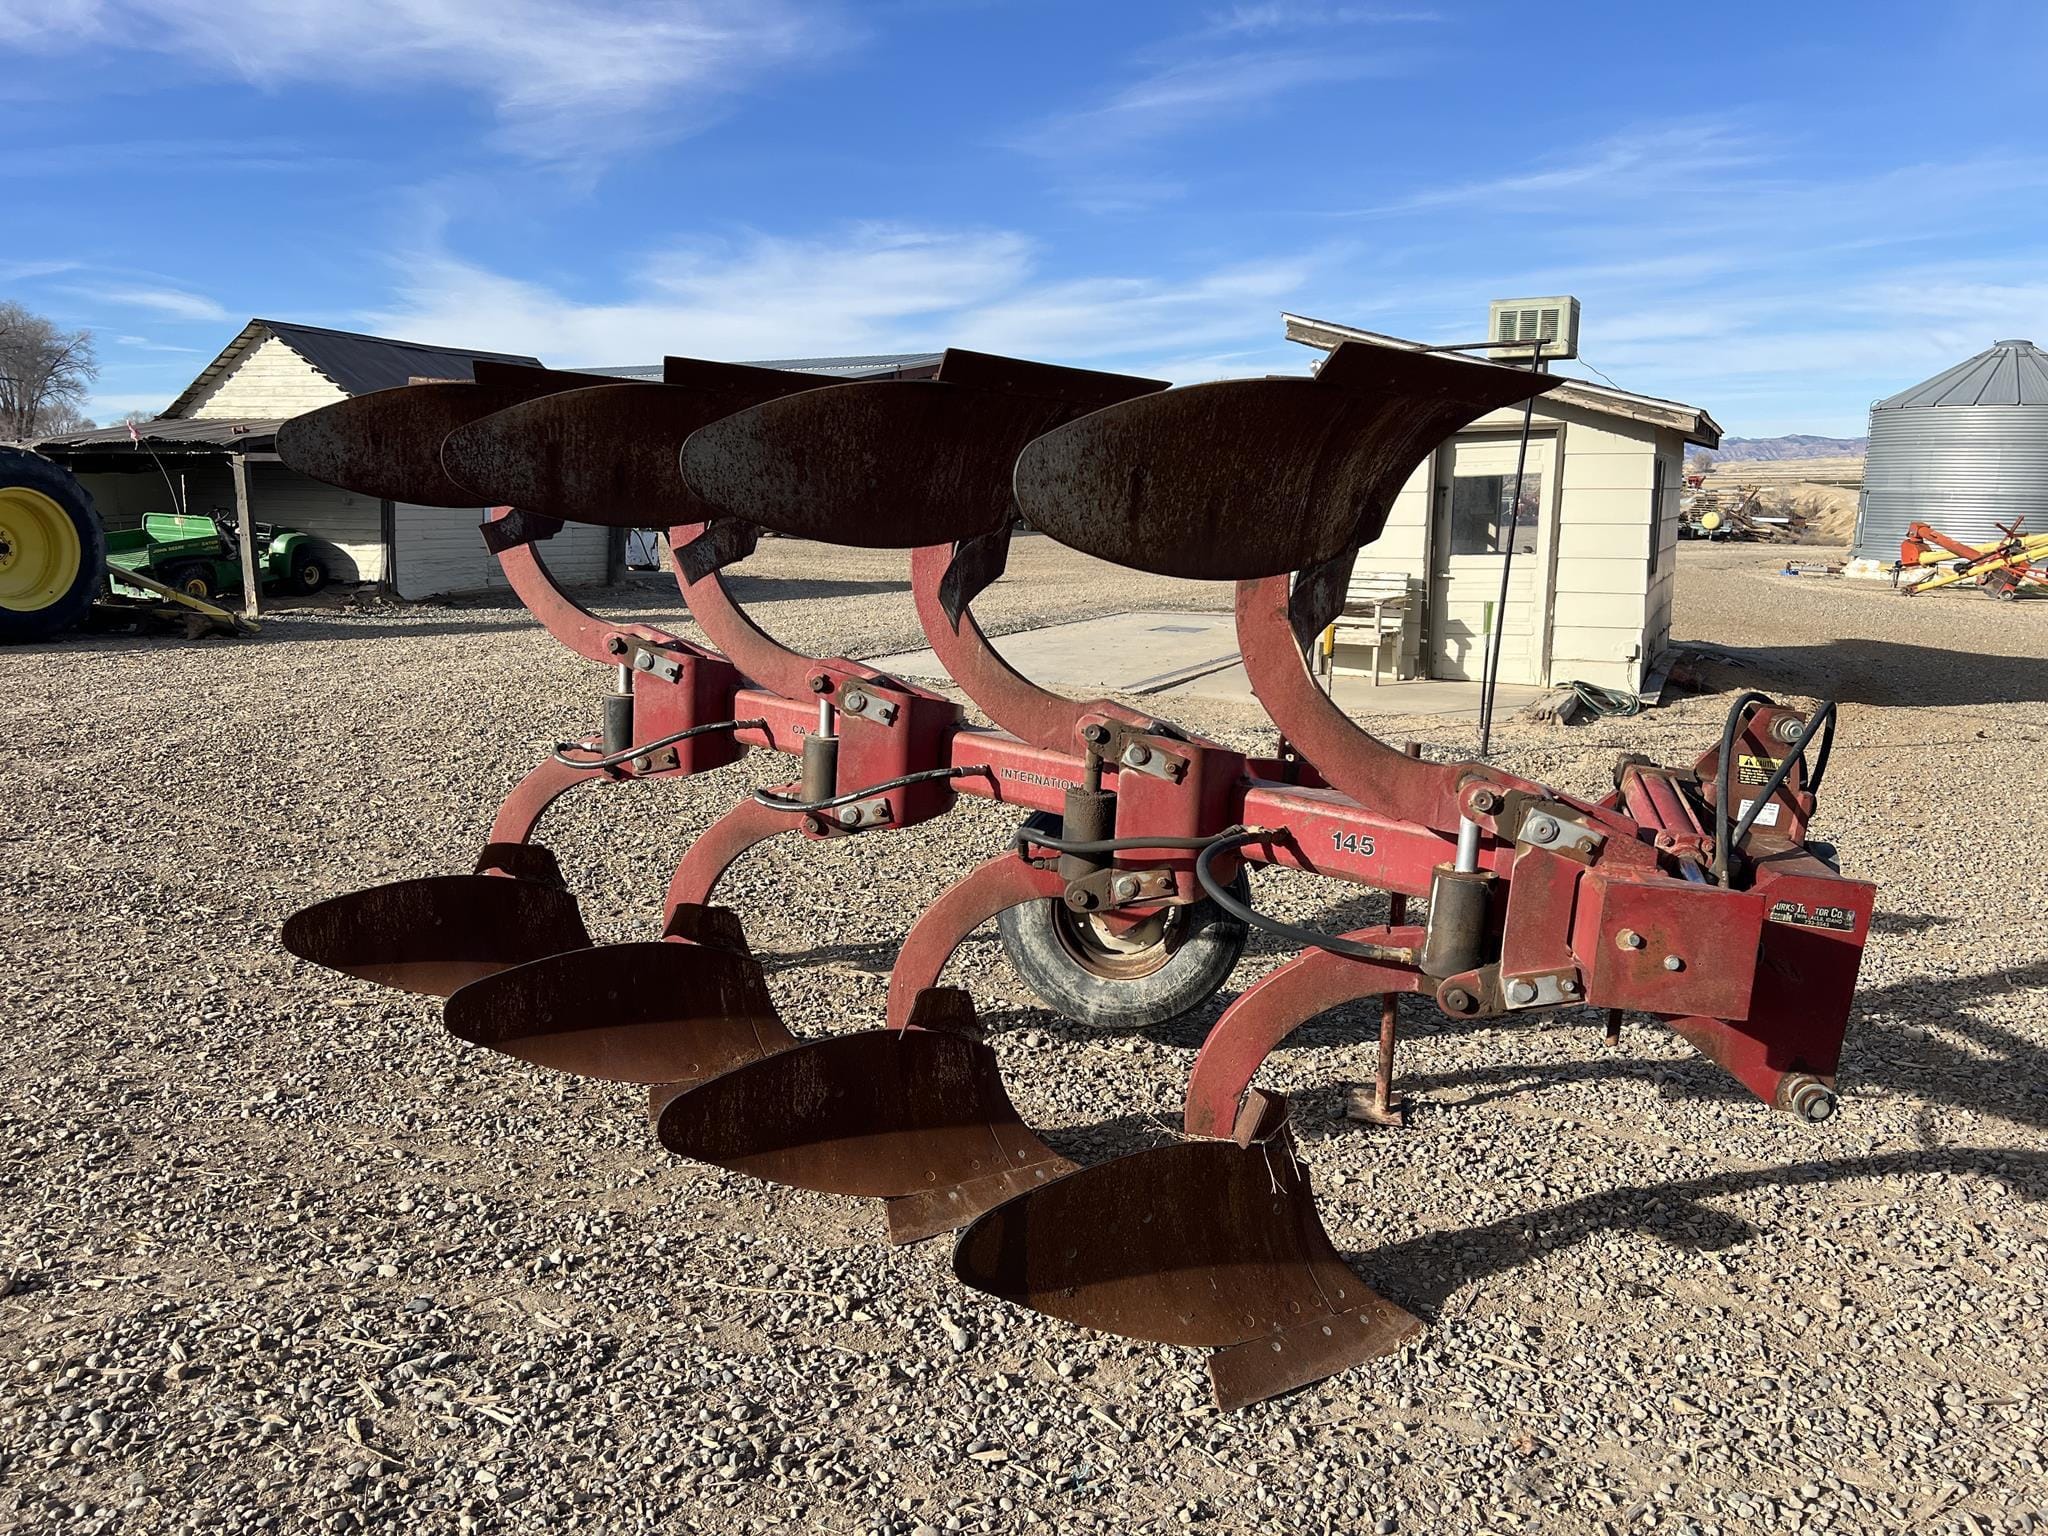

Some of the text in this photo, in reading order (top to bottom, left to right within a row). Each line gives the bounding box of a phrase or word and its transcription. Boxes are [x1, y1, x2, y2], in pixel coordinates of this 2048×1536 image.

[1000, 768, 1084, 791] INTERNATION
[1331, 830, 1375, 857] 145
[1796, 903, 1829, 916] TRTOR
